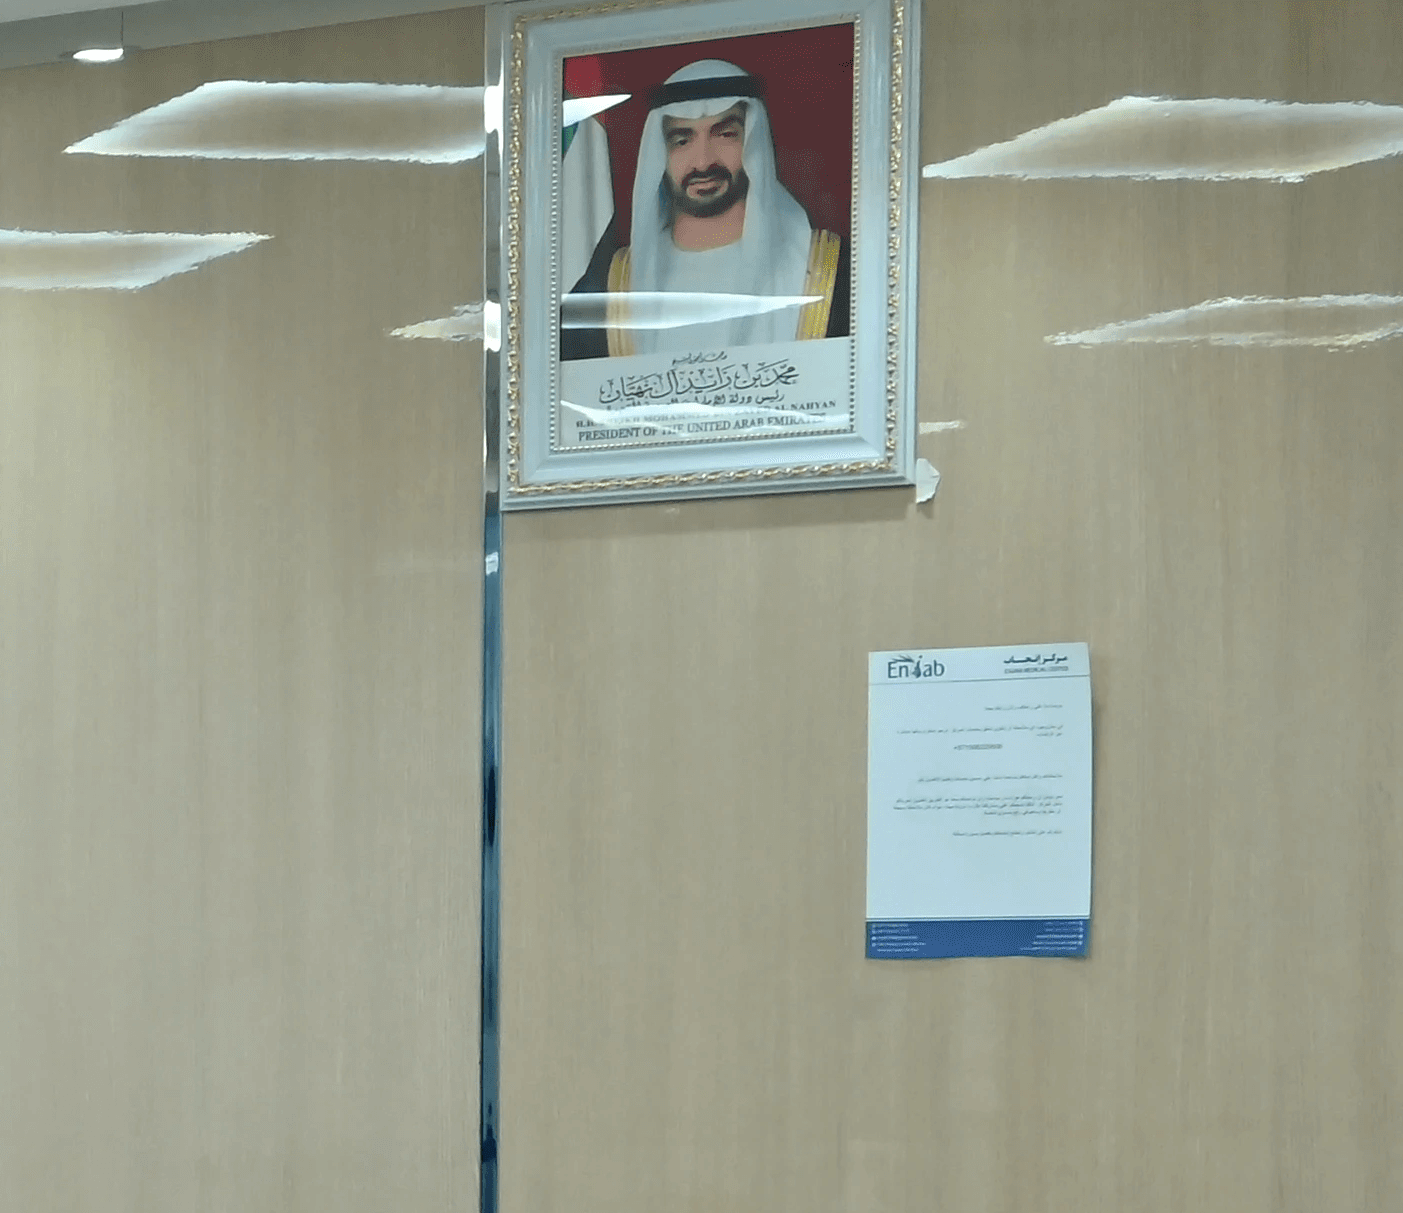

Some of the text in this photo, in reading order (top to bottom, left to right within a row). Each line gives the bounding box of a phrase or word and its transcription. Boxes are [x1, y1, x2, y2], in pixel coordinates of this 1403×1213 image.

[578, 426, 640, 441] PRESIDENT
[687, 420, 731, 433] UNITED
[732, 418, 764, 430] ARAB
[767, 412, 826, 427] EMIRA
[888, 655, 945, 679] Enjab
